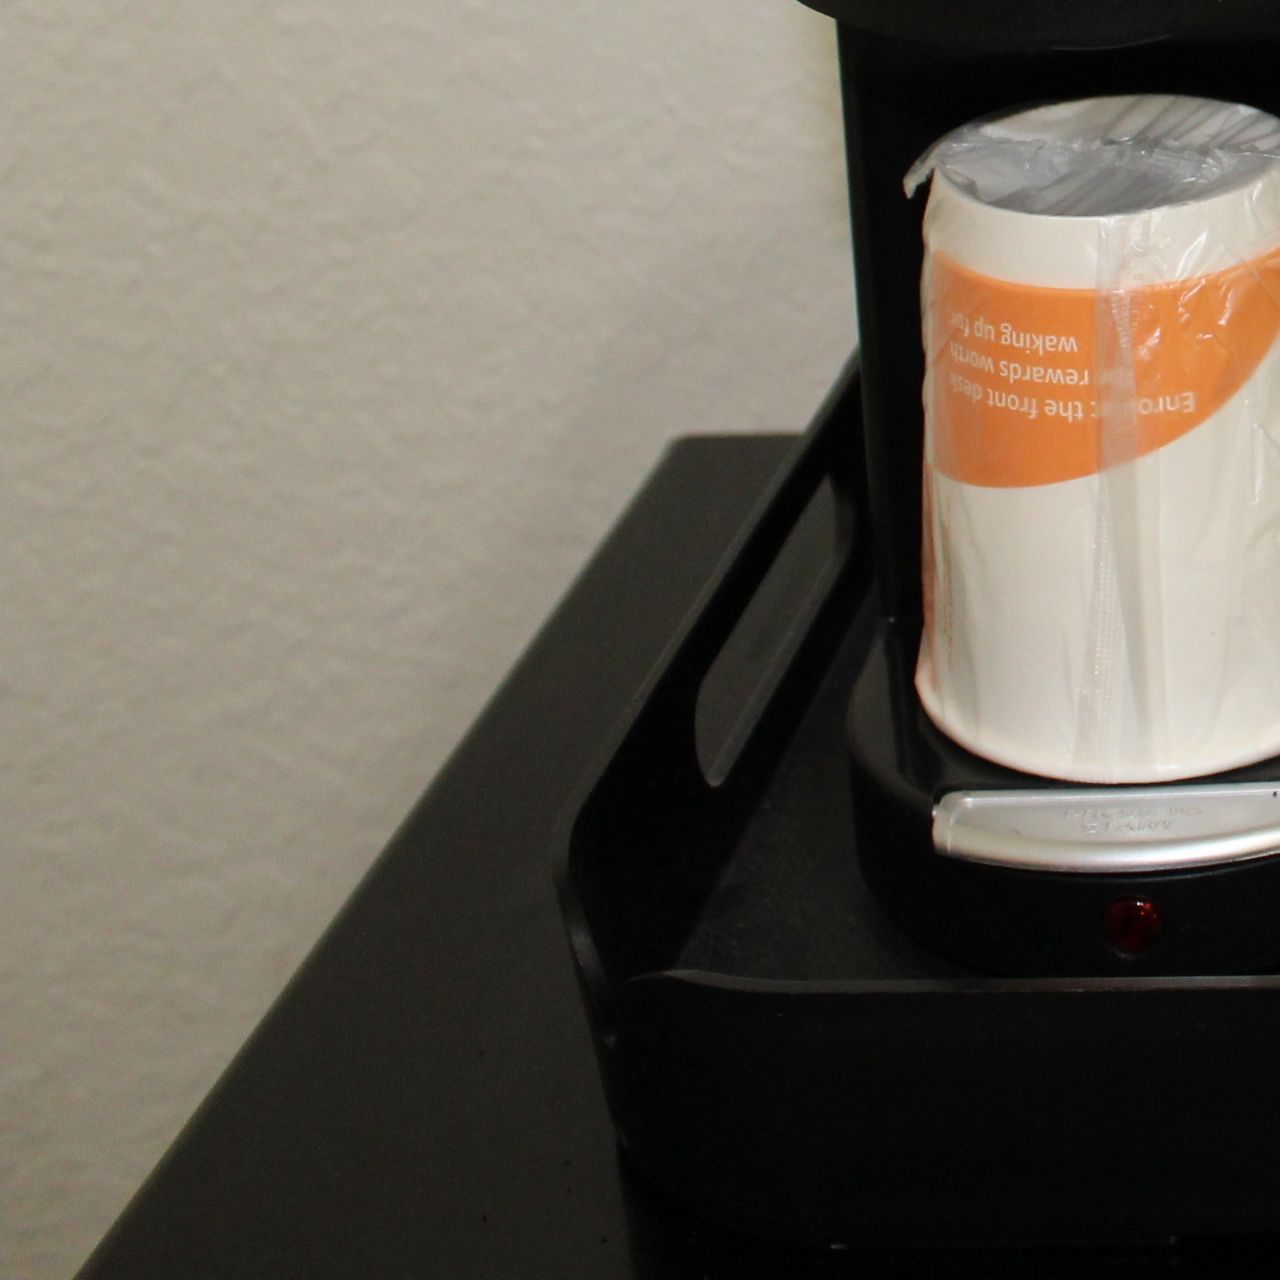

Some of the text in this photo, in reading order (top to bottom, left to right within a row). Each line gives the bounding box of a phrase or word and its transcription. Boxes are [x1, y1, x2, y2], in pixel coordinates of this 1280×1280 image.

[974, 317, 995, 340] up
[1000, 323, 1079, 357] waking
[1000, 360, 1089, 386] rewards
[987, 388, 1040, 420] front
[1043, 399, 1084, 422] the
[1124, 391, 1196, 417] Enro
